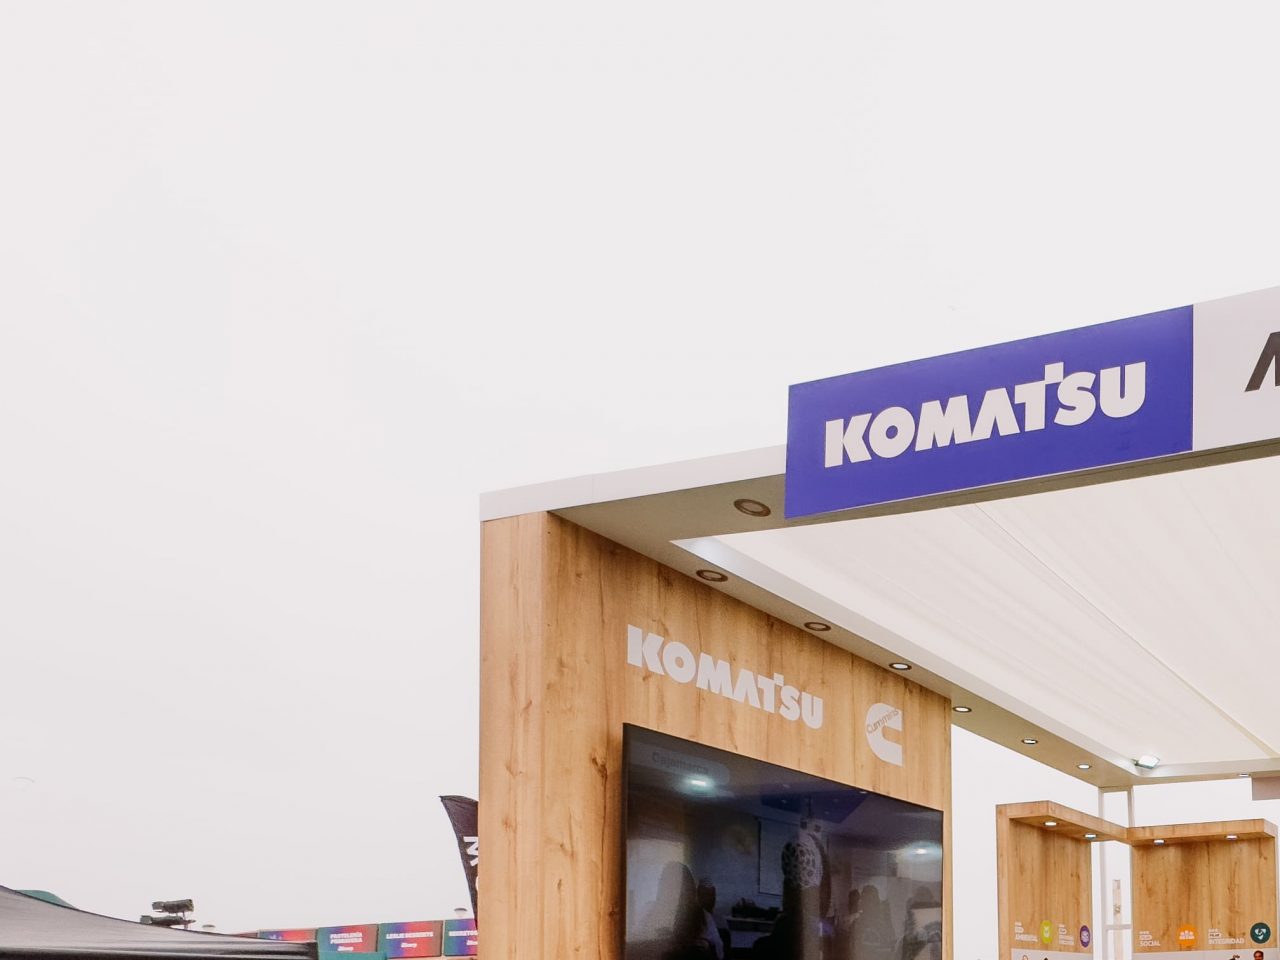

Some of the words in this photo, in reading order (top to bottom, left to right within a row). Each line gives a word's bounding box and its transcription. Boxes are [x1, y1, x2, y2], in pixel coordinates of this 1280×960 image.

[825, 361, 1146, 468] KOMATSU
[627, 624, 824, 729] KOMATSU
[866, 709, 900, 734] Cummins
